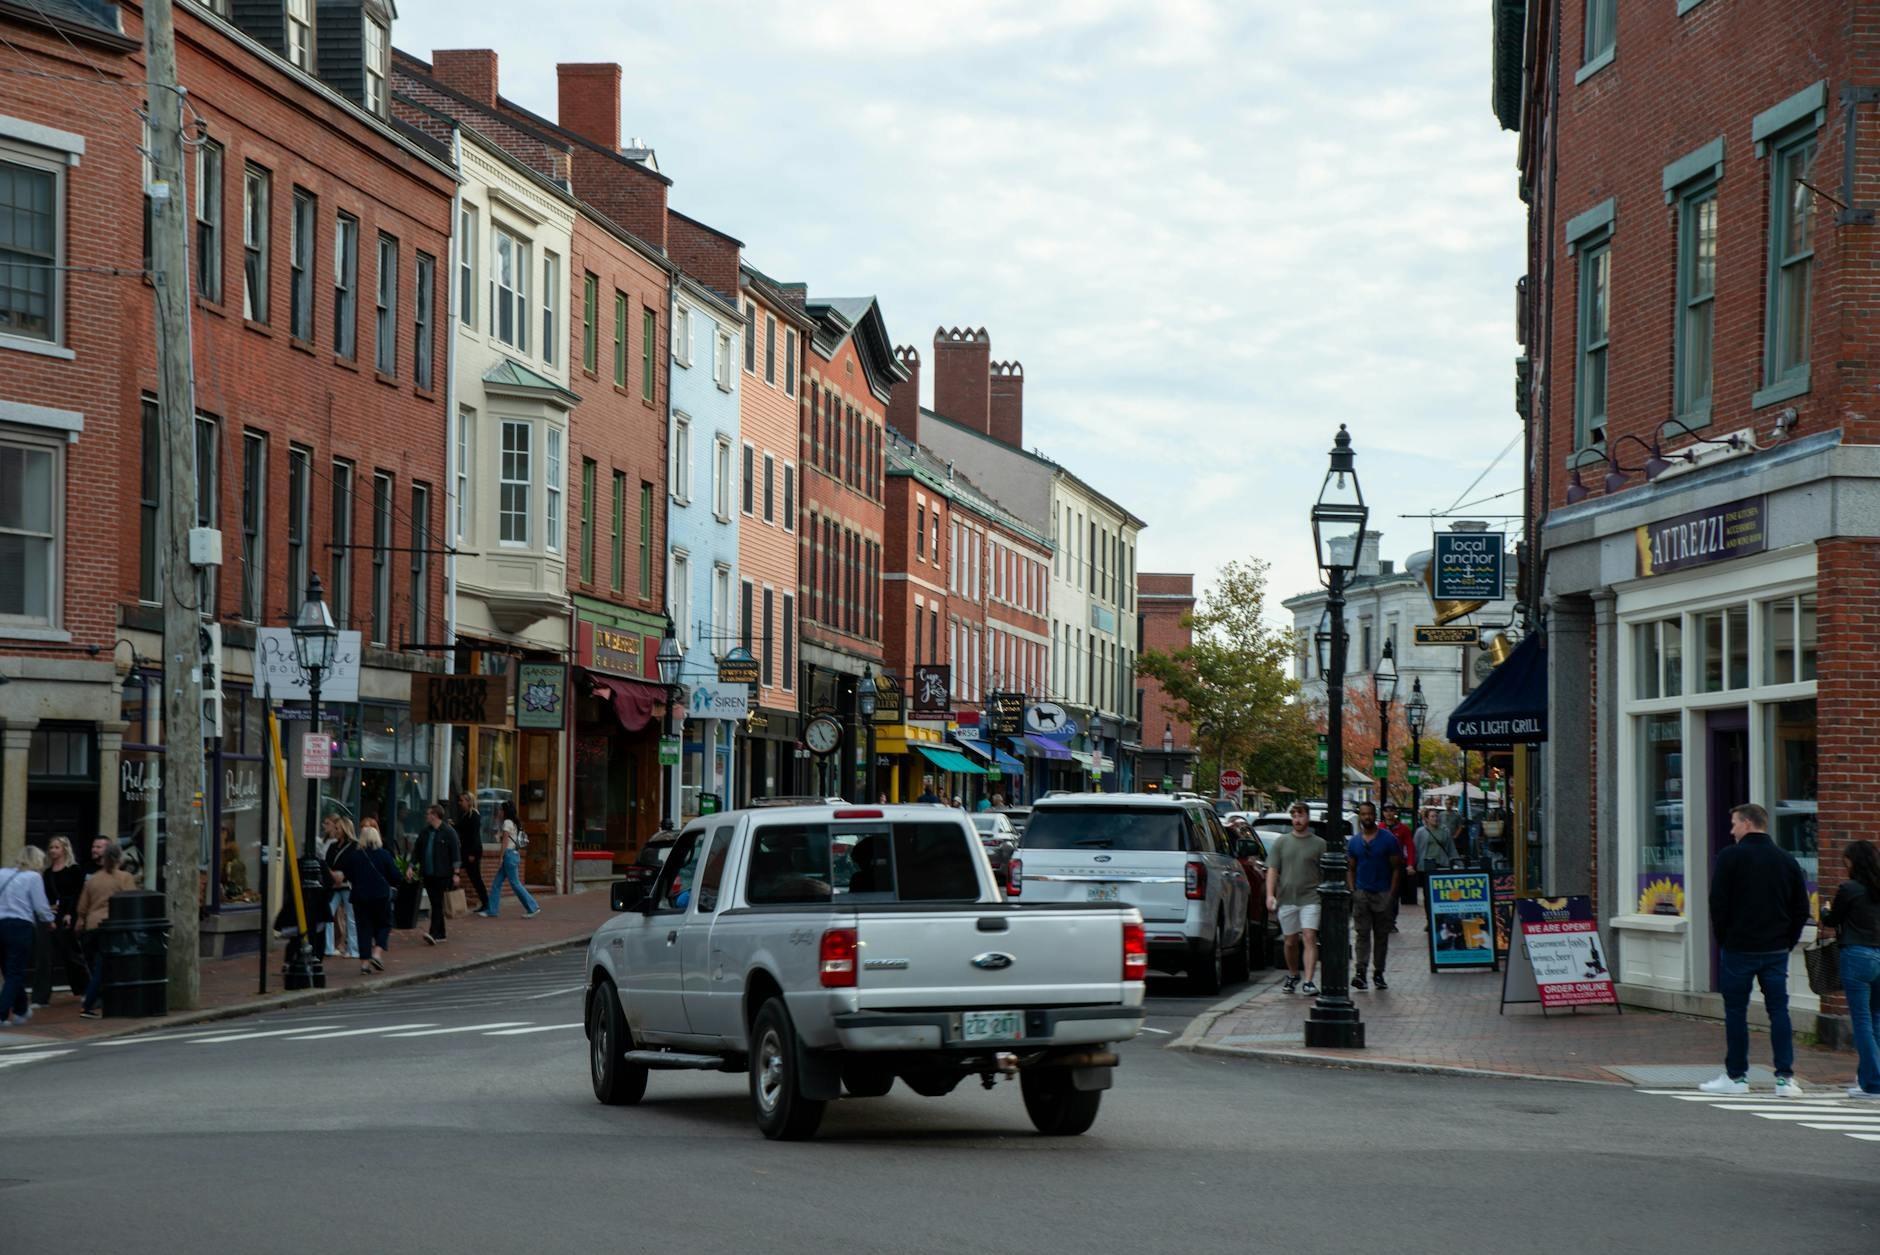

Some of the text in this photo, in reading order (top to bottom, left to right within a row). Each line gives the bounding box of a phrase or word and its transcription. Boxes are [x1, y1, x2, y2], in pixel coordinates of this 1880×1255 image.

[1451, 538, 1486, 551] local
[1654, 515, 1725, 565] ATTREZZI
[1443, 551, 1494, 564] anchor
[428, 678, 487, 697] FLOWER
[714, 696, 746, 708] SIREN
[428, 696, 487, 721] KIOSK
[1456, 718, 1541, 735] GAS LIGHT GRILL
[1221, 776, 1241, 785] STOP
[1432, 878, 1486, 890] HAPPY
[1440, 889, 1483, 901] HOUR
[1527, 924, 1542, 933] WE
[1543, 923, 1561, 933] ARE
[1544, 982, 1608, 994] ORDER ONLINE
